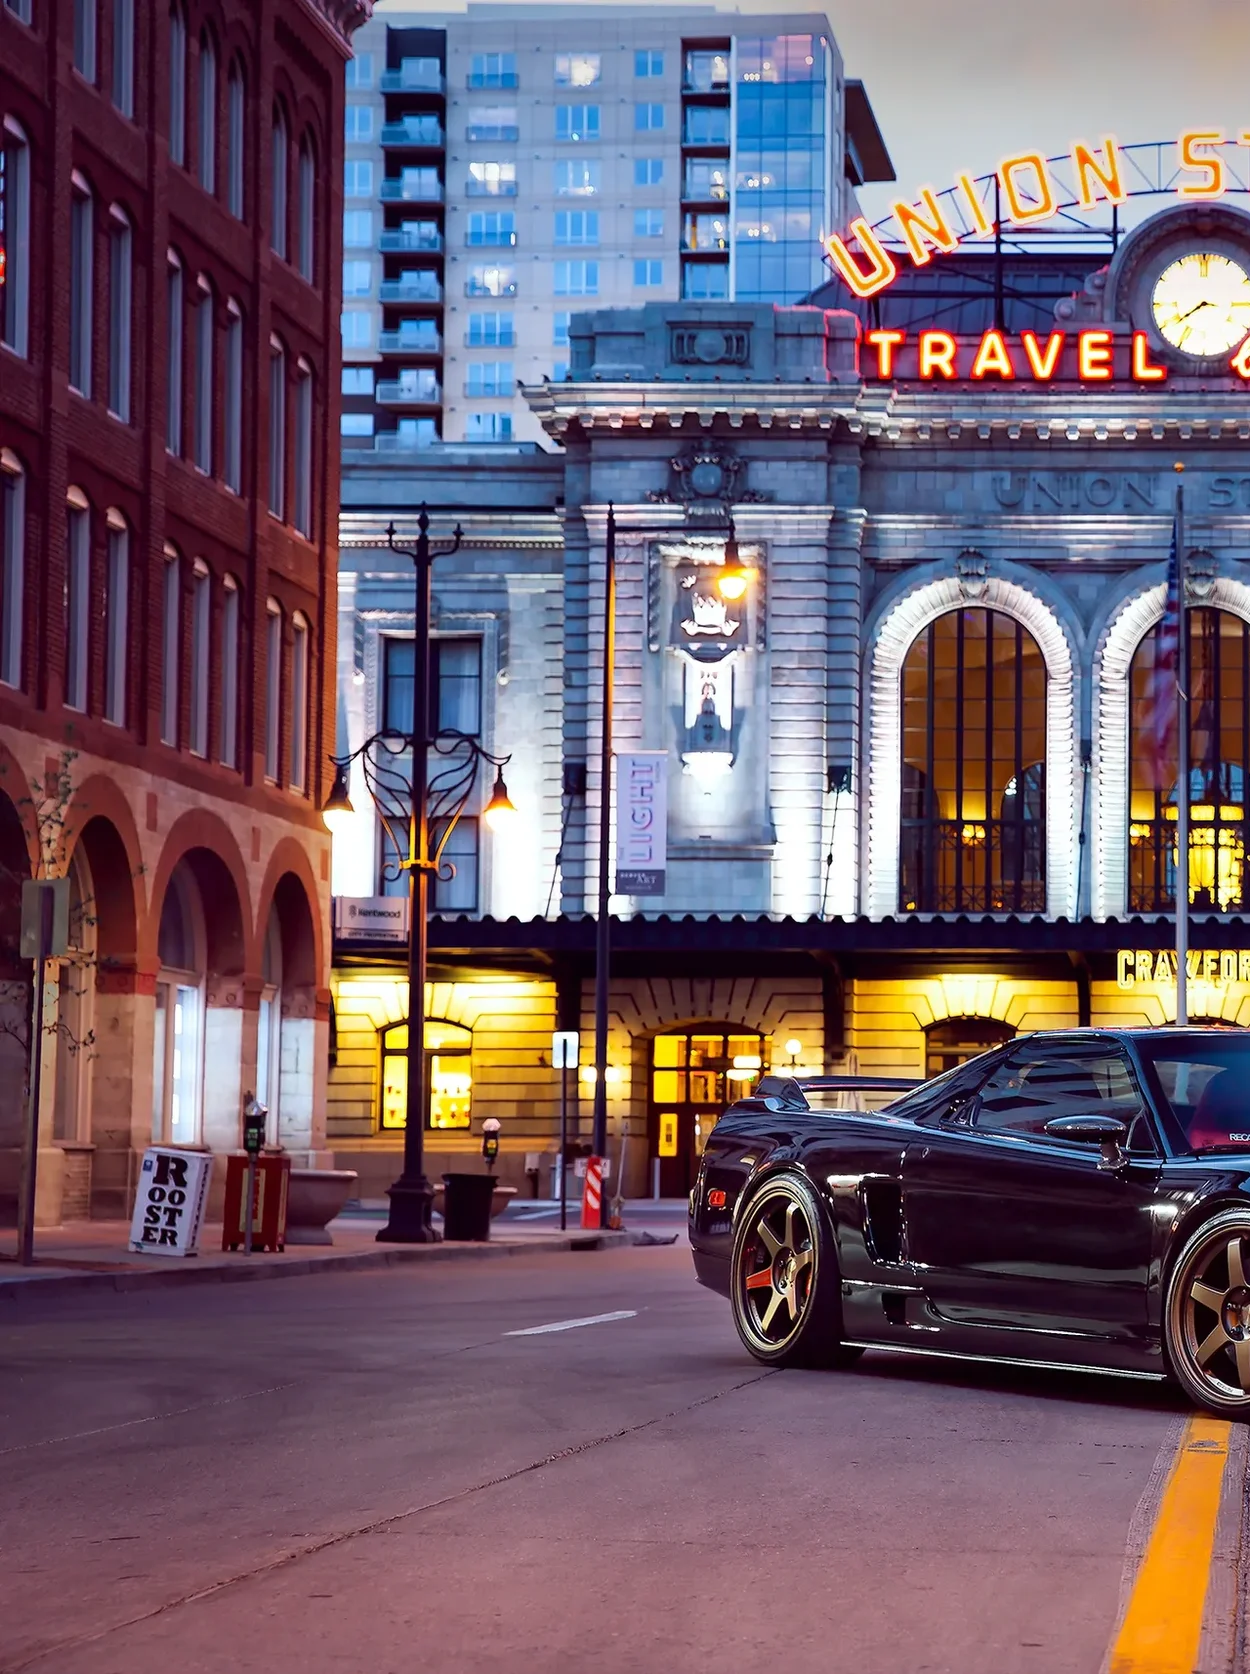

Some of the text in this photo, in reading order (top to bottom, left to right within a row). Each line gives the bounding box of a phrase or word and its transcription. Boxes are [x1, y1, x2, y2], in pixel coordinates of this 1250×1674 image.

[822, 138, 1124, 299] UNION
[867, 330, 1168, 380] TRAVEL
[992, 476, 1158, 508] UNION
[630, 759, 654, 863] LIGHT
[358, 908, 401, 919] Kentwood
